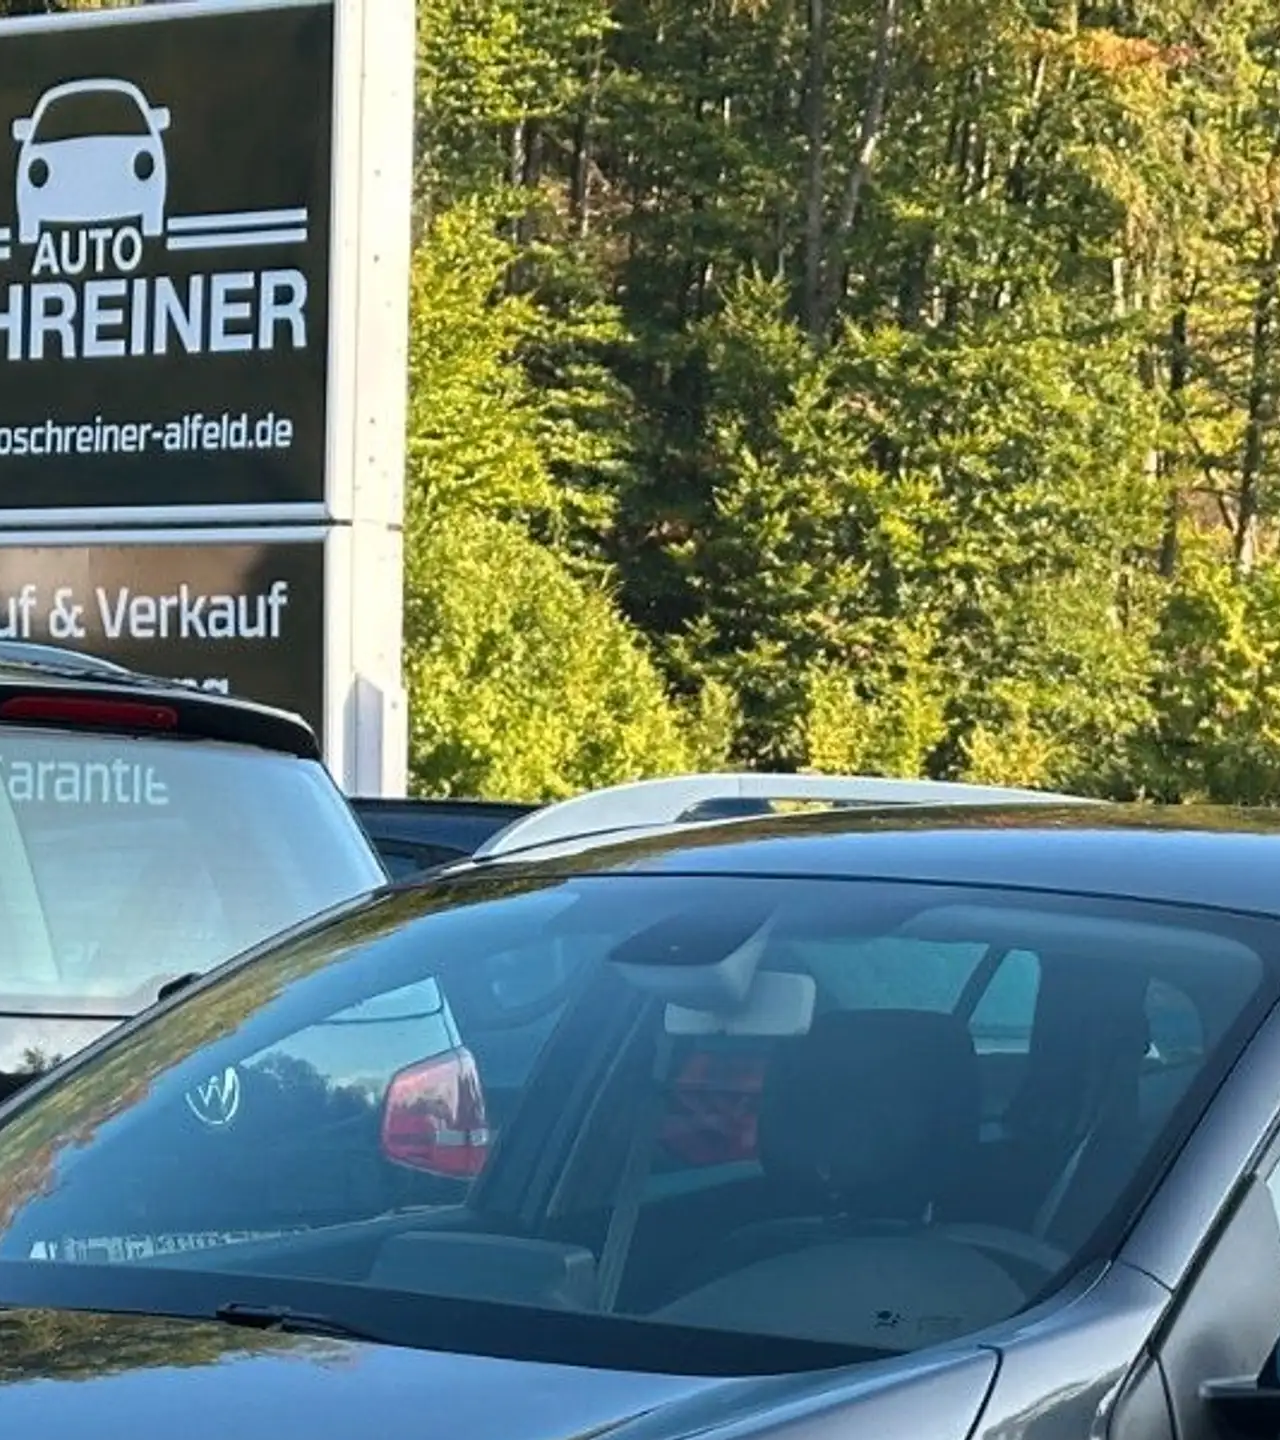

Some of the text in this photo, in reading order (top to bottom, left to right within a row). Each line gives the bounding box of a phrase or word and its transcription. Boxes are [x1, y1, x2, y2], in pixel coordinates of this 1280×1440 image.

[31, 226, 143, 276] AUTO
[49, 587, 86, 638] &
[96, 580, 287, 638] Verkauf
